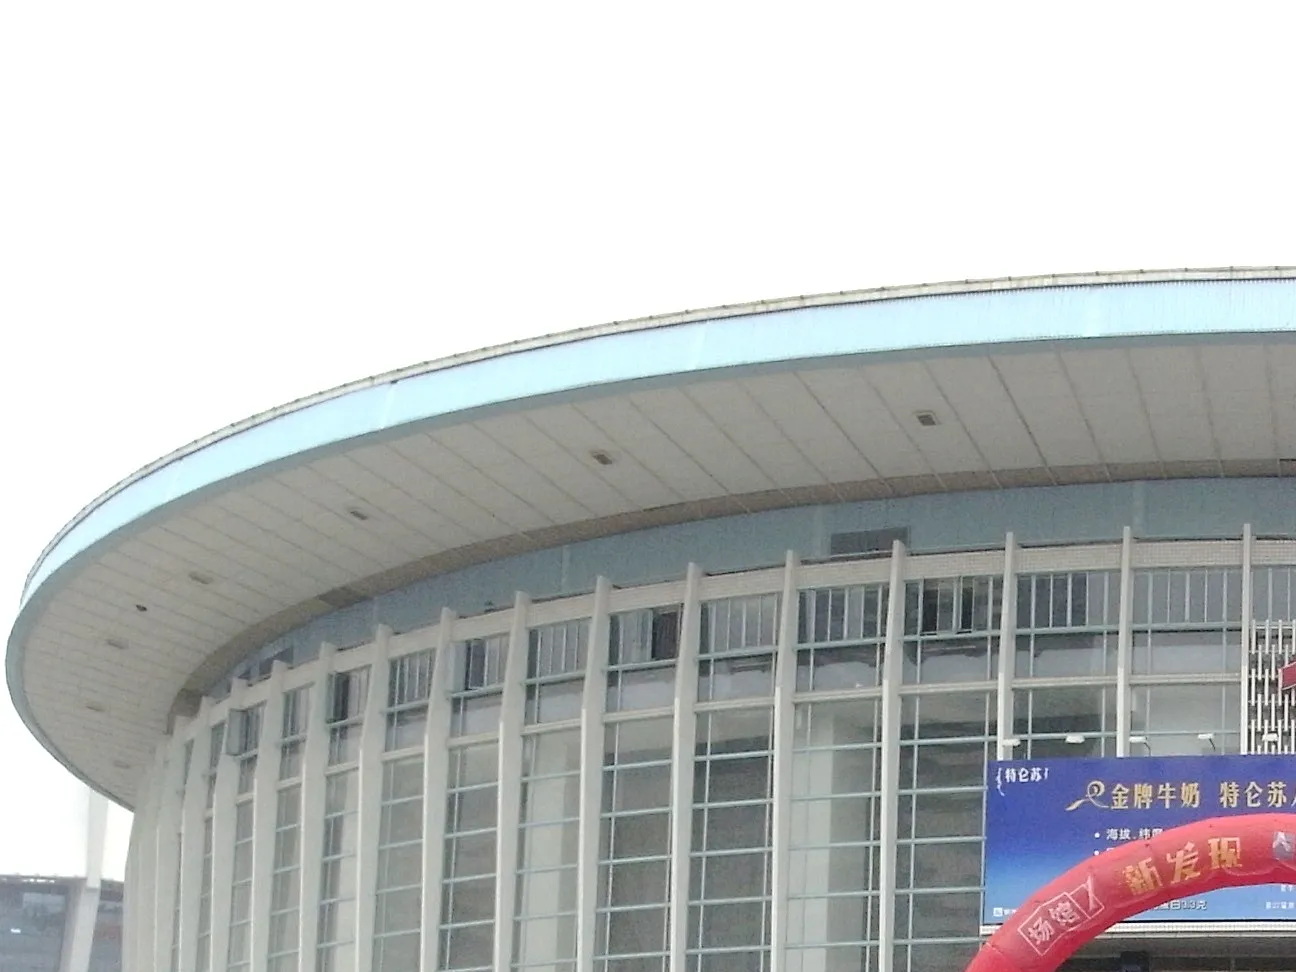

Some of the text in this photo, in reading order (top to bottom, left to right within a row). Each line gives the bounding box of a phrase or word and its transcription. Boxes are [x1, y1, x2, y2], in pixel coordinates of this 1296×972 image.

[1005, 767, 1042, 783] 特仑苏
[1111, 782, 1200, 809] 金牌牛奶
[1122, 837, 1243, 896] 新发现
